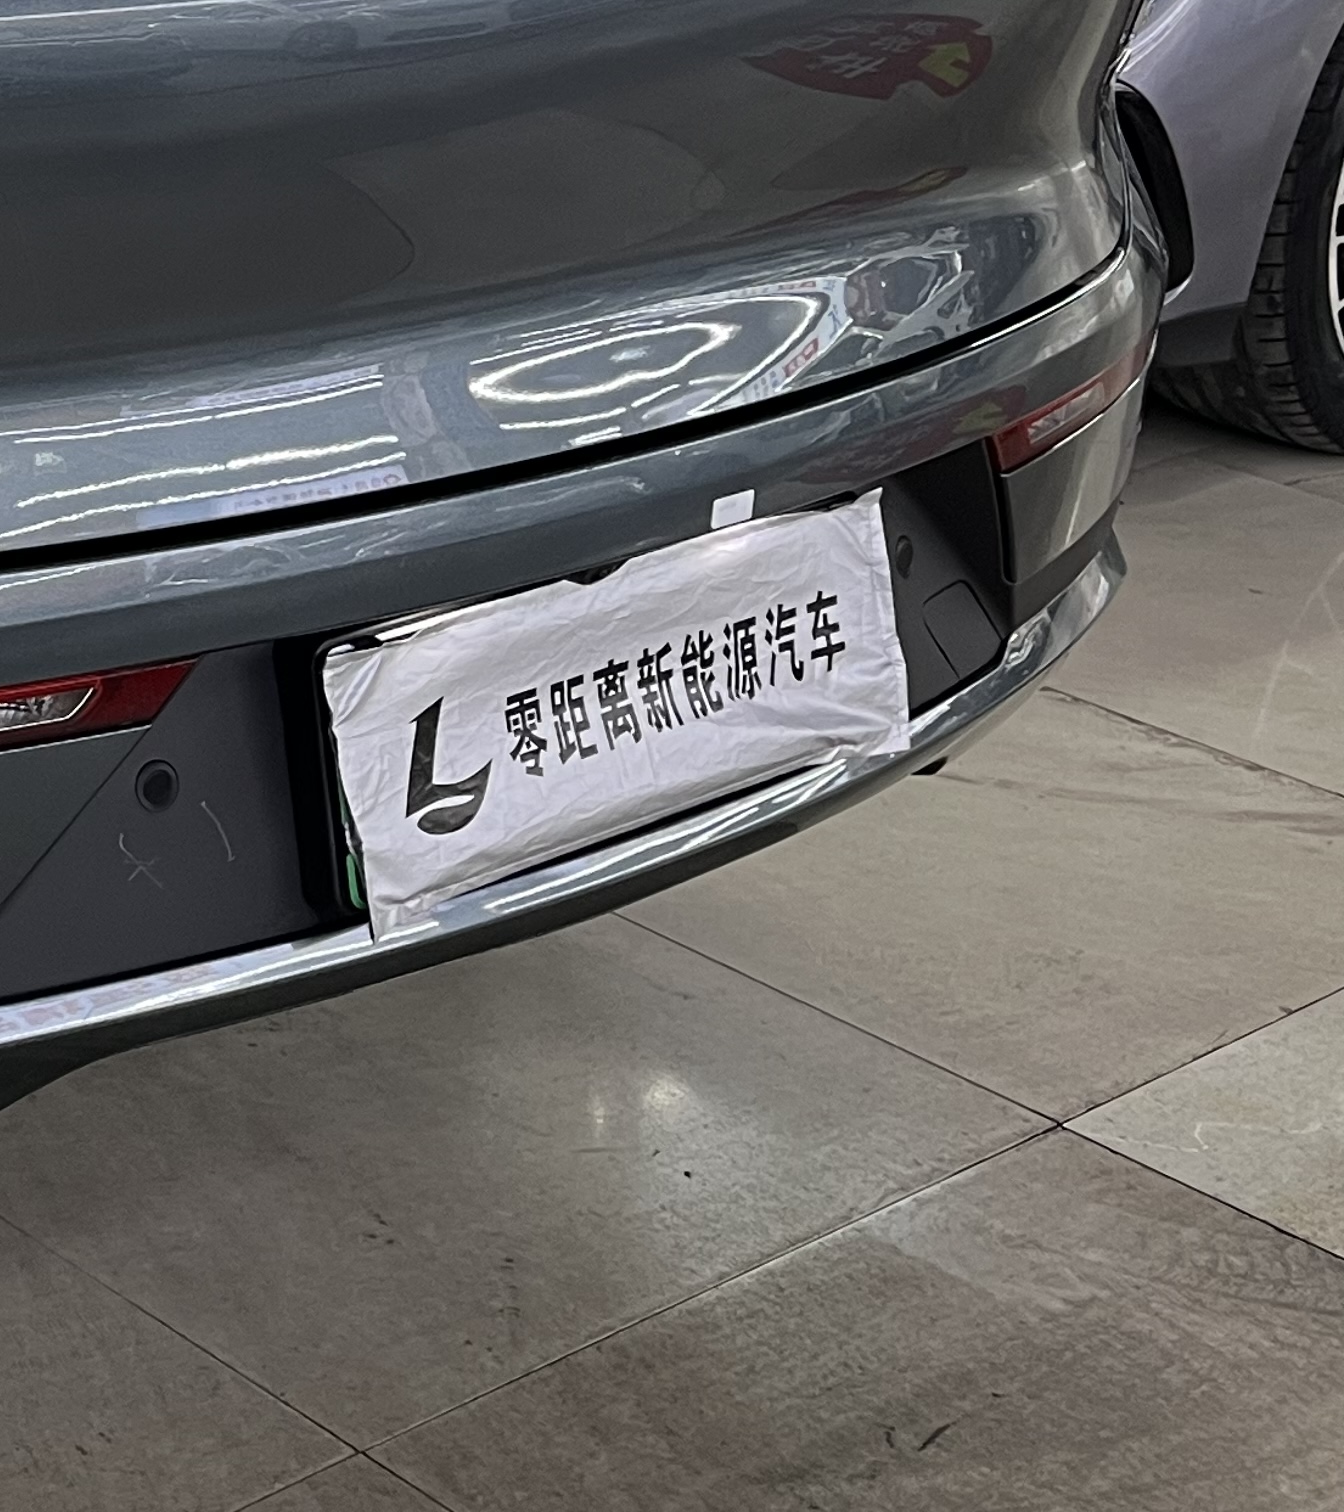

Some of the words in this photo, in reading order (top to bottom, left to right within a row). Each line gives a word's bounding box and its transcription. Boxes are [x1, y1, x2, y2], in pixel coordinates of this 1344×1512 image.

[504, 589, 848, 778] 零距离新能源汽车
